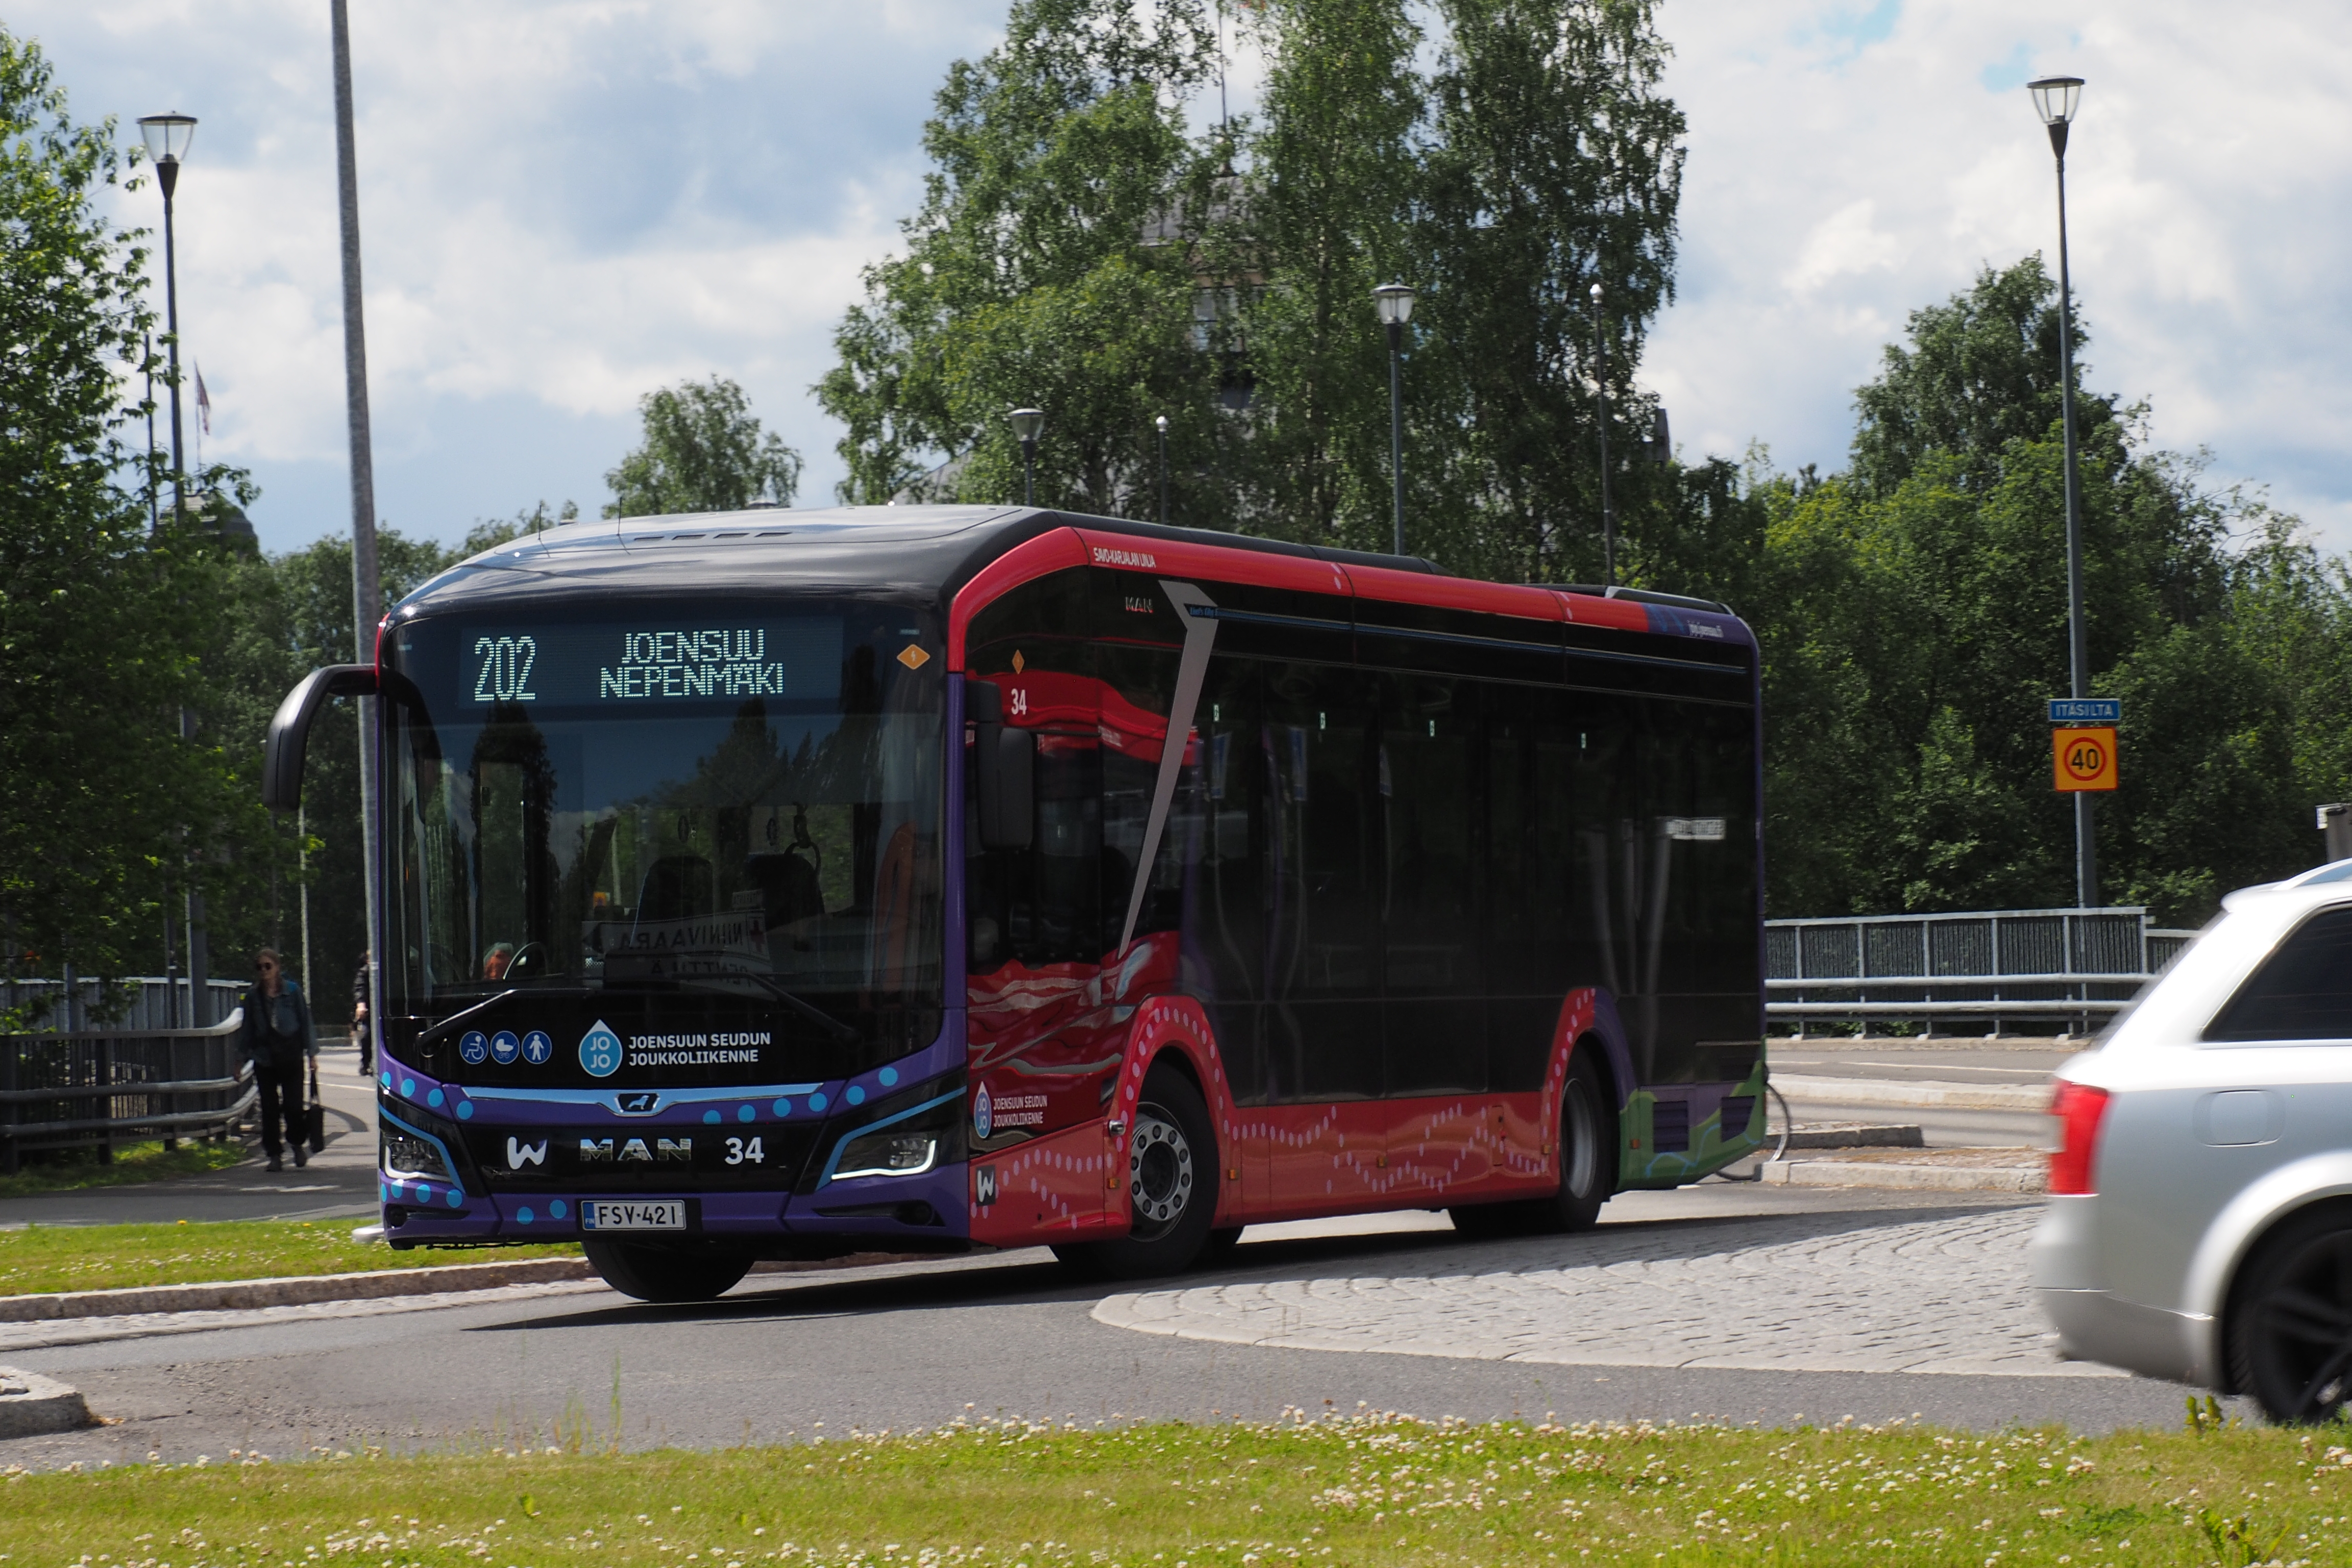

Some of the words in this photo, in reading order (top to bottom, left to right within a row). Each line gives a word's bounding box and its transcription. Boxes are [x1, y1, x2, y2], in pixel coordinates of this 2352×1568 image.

[1125, 596, 1154, 614] MAN
[621, 629, 764, 664] JOENSUU
[475, 636, 536, 701] 202
[600, 663, 784, 698] NEPENMÄKI
[1011, 688, 1027, 715] 34
[2055, 702, 2114, 716] ITÄSILTA
[2071, 748, 2099, 770] 40
[590, 1037, 610, 1051] JO
[628, 1034, 707, 1049] JOENSUUN
[710, 1032, 771, 1047] SEUDUN
[590, 1054, 611, 1068] JO
[628, 1049, 759, 1066] JOUKKOLIIKENNE
[978, 1097, 987, 1112] JO
[993, 1097, 1024, 1111] JOENSUUN
[1024, 1095, 1047, 1108] SEUDUN
[978, 1115, 987, 1130] JO
[993, 1112, 1043, 1128] JOUKKOLIIKENNE
[580, 1138, 692, 1161] MAN
[724, 1137, 765, 1165] 34
[598, 1205, 676, 1226] FSV-421
